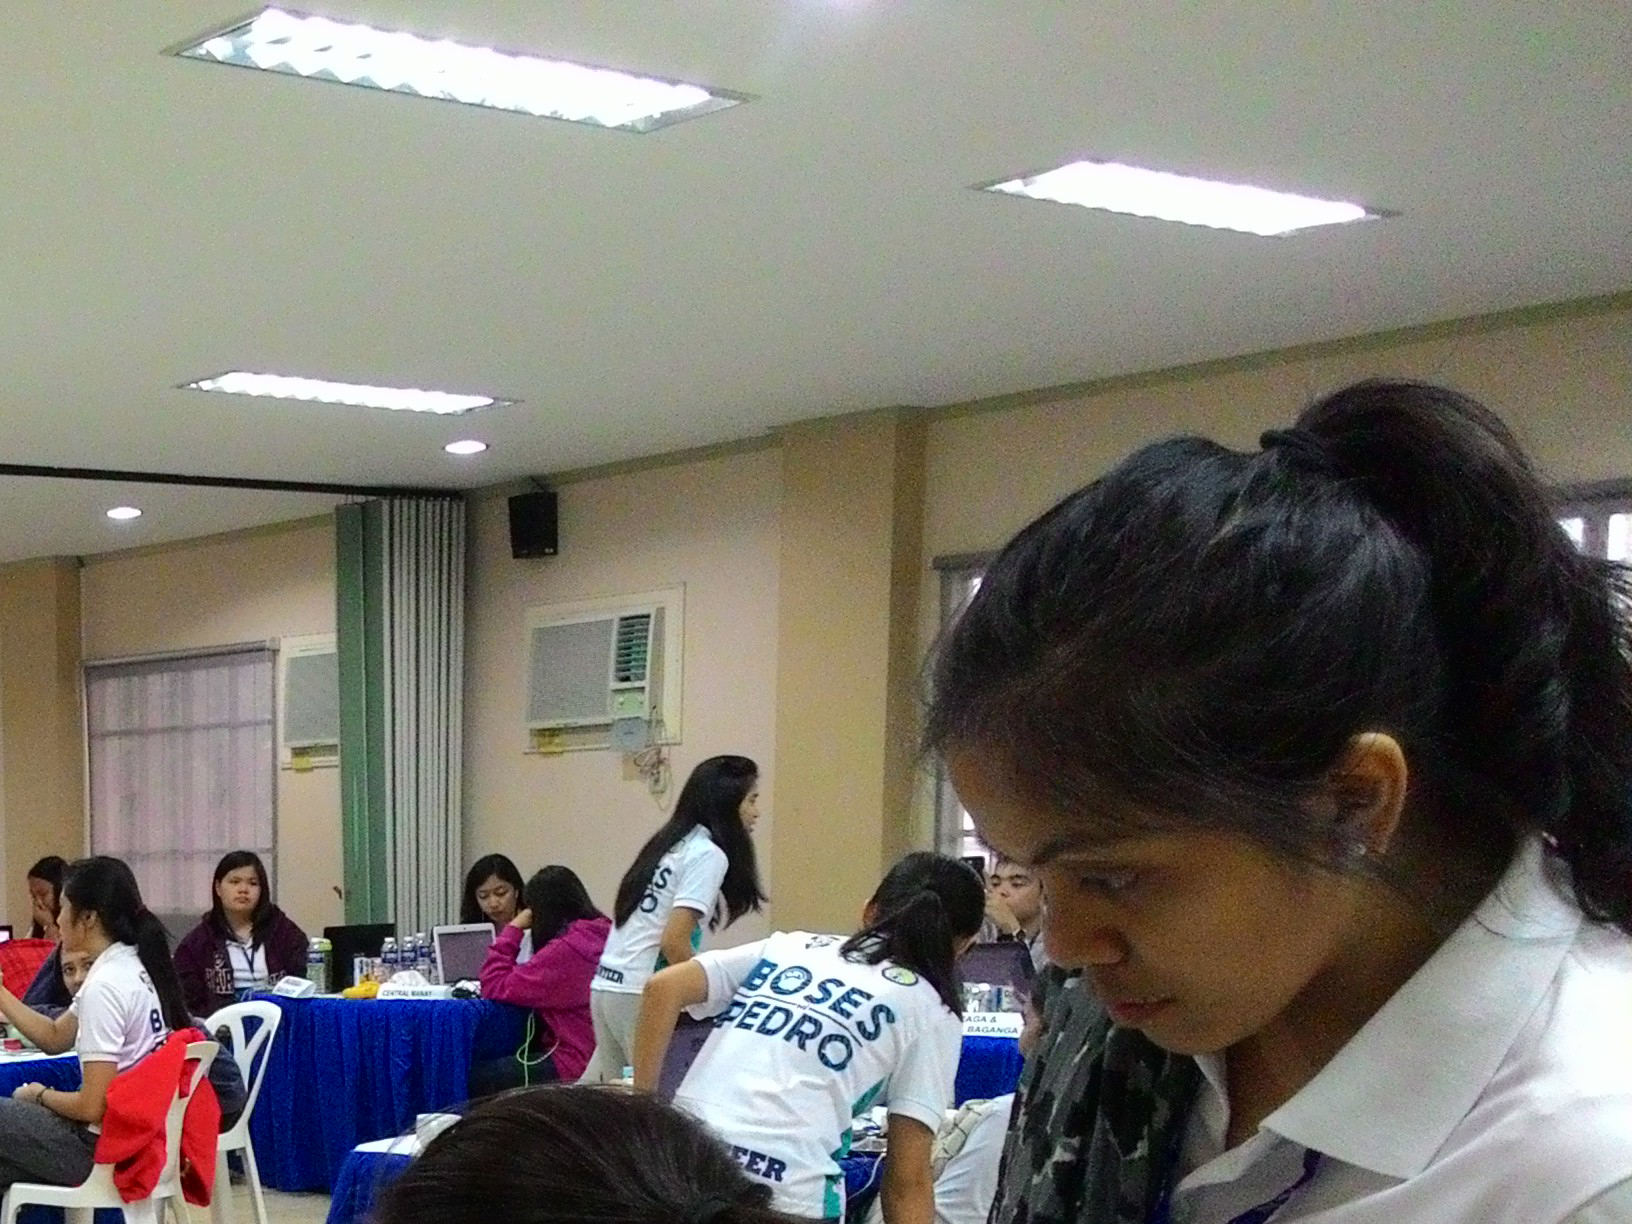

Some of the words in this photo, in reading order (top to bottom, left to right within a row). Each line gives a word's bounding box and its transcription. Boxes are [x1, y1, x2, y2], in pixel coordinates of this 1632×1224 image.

[741, 958, 896, 1042] BOSES
[962, 1015, 987, 1023] AGA
[713, 1000, 854, 1072] PEDRO
[967, 1025, 1018, 1034] BAGANGA
